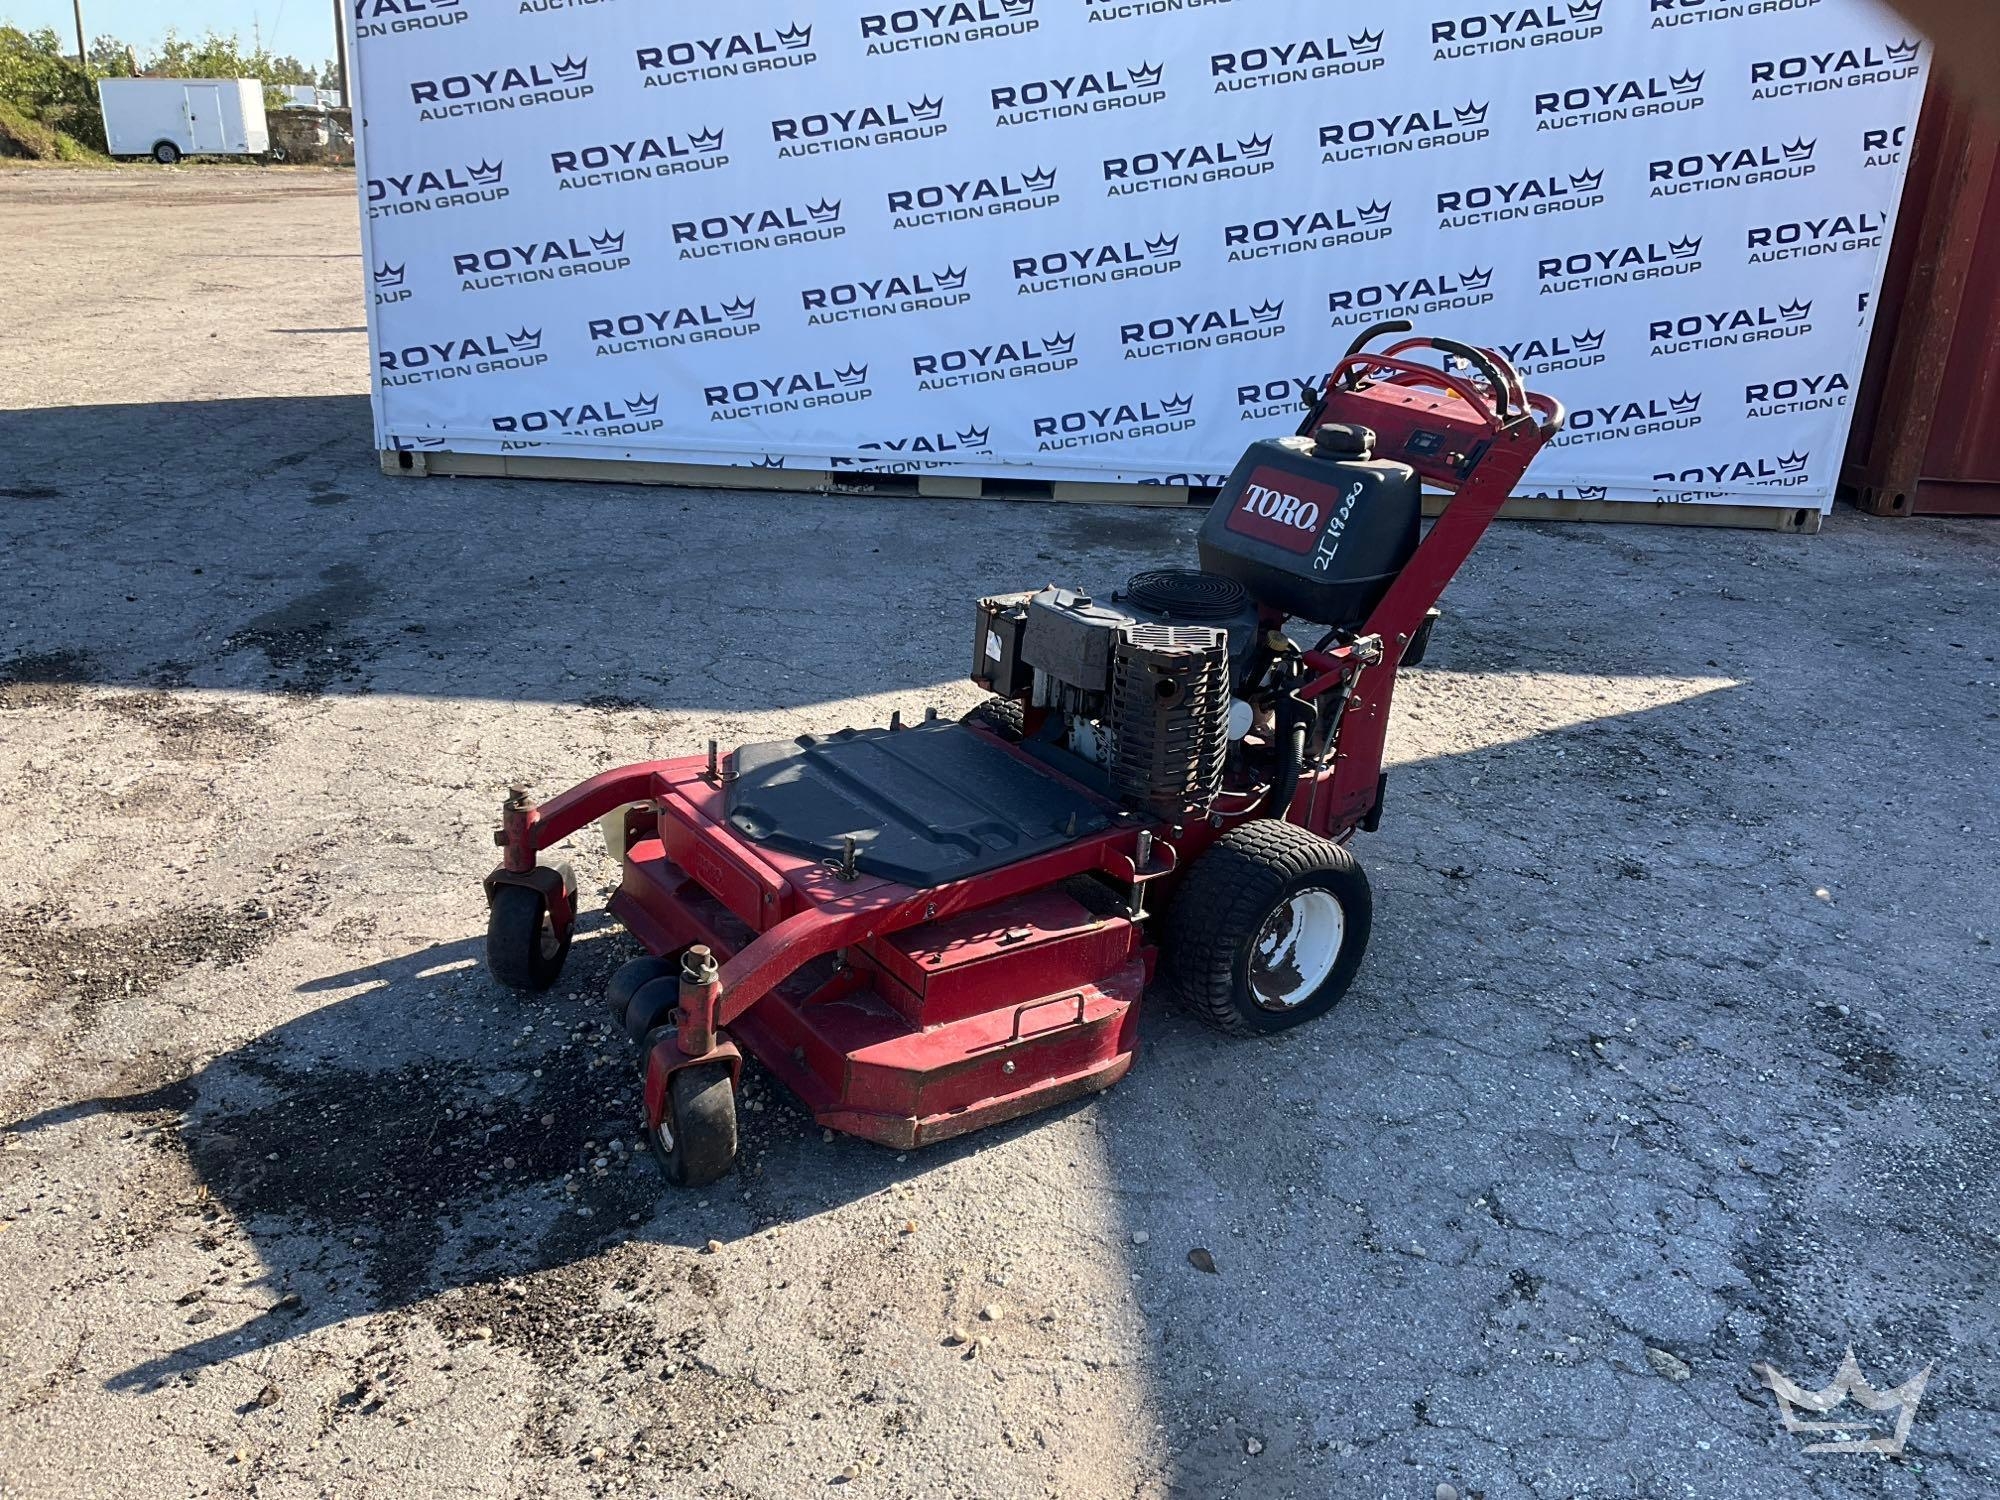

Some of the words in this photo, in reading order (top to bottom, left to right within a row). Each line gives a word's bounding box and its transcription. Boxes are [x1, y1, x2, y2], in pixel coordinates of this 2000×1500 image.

[392, 11, 468, 33] GROUP
[861, 0, 1000, 38] ROYAL
[1089, 0, 1183, 23] AUCTION
[1432, 4, 1567, 43] ROYAL
[1651, 6, 1743, 29] AUCTION
[637, 29, 777, 70] ROYAL
[867, 32, 960, 56] AUCTION
[965, 20, 1039, 41] GROUP
[1434, 37, 1525, 60] AUCTION
[1531, 26, 1602, 46] GROUP
[644, 64, 738, 88] AUCTION
[743, 53, 816, 73] GROUP
[1211, 35, 1348, 76] ROYAL
[1752, 45, 1885, 83] ROYAL
[411, 63, 553, 104] ROYAL
[991, 69, 1128, 109] ROYAL
[1215, 69, 1307, 93] AUCTION
[1312, 58, 1384, 78] GROUP
[1752, 77, 1842, 100] AUCTION
[1848, 66, 1919, 86] GROUP
[420, 97, 514, 121] AUCTION
[519, 85, 593, 106] GROUP
[996, 103, 1088, 127] AUCTION
[1093, 91, 1165, 111] GROUP
[1536, 76, 1668, 115] ROYAL
[772, 102, 910, 141] ROYAL
[1320, 108, 1453, 147] ROYAL
[1537, 108, 1627, 131] AUCTION
[1632, 98, 1703, 117] GROUP
[551, 134, 689, 173] ROYAL
[779, 136, 870, 159] AUCTION
[875, 125, 947, 144] GROUP
[1322, 140, 1412, 164] AUCTION
[1418, 129, 1489, 149] GROUP
[560, 167, 651, 190] AUCTION
[656, 156, 729, 176] GROUP
[1104, 140, 1237, 180] ROYAL
[1650, 144, 1781, 181] ROYAL
[888, 174, 1023, 212] ROYAL
[1108, 173, 1197, 196] AUCTION
[1203, 162, 1274, 182] GROUP
[1438, 175, 1568, 213] ROYAL
[1650, 176, 1740, 197] AUCTION
[1746, 165, 1815, 184] GROUP
[436, 188, 509, 208] GROUP
[894, 206, 983, 229] AUCTION
[988, 195, 1059, 215] GROUP
[1439, 206, 1528, 229] AUCTION
[1534, 195, 1603, 214] GROUP
[672, 205, 808, 243] ROYAL
[1225, 207, 1356, 246] ROYAL
[1748, 214, 1878, 248] ROYAL
[454, 237, 591, 275] ROYAL
[679, 238, 769, 260] AUCTION
[774, 227, 845, 246] GROUP
[1013, 240, 1145, 279] ROYAL
[1228, 239, 1316, 262] AUCTION
[1322, 228, 1392, 247] GROUP
[1539, 241, 1667, 279] ROYAL
[1748, 242, 1837, 264] AUCTION
[462, 268, 554, 291] AUCTION
[559, 258, 630, 277] GROUP
[802, 273, 934, 310] ROYAL
[1018, 272, 1106, 295] AUCTION
[1111, 261, 1181, 280] GROUP
[1540, 272, 1627, 295] AUCTION
[1633, 262, 1701, 280] GROUP
[808, 304, 896, 325] AUCTION
[901, 293, 970, 312] GROUP
[1329, 274, 1458, 312] ROYAL
[1331, 305, 1419, 327] AUCTION
[1425, 293, 1493, 312] GROUP
[589, 304, 722, 340] ROYAL
[1121, 306, 1250, 344] ROYAL
[1650, 305, 1777, 341] ROYAL
[380, 336, 508, 370] ROYAL
[596, 334, 685, 356] AUCTION
[690, 324, 760, 342] GROUP
[913, 339, 1043, 375] ROYAL
[1125, 337, 1211, 359] AUCTION
[1216, 326, 1285, 345] GROUP
[1651, 335, 1737, 356] AUCTION
[1743, 325, 1811, 342] GROUP
[382, 365, 472, 388] AUCTION
[476, 354, 547, 373] GROUP
[919, 369, 1004, 391] AUCTION
[1010, 358, 1078, 377] GROUP
[1537, 355, 1605, 373] GROUP
[704, 369, 836, 406] ROYAL
[492, 402, 626, 433] ROYAL
[711, 400, 798, 421] AUCTION
[803, 389, 871, 408] GROUP
[1034, 400, 1161, 437] ROYAL
[1747, 398, 1832, 419] AUCTION
[593, 420, 664, 437] GROUP
[1039, 430, 1123, 452] AUCTION
[1129, 419, 1195, 438] GROUP
[1546, 427, 1630, 449] AUCTION
[1635, 417, 1701, 435] GROUP
[1242, 484, 1319, 530] TORO
